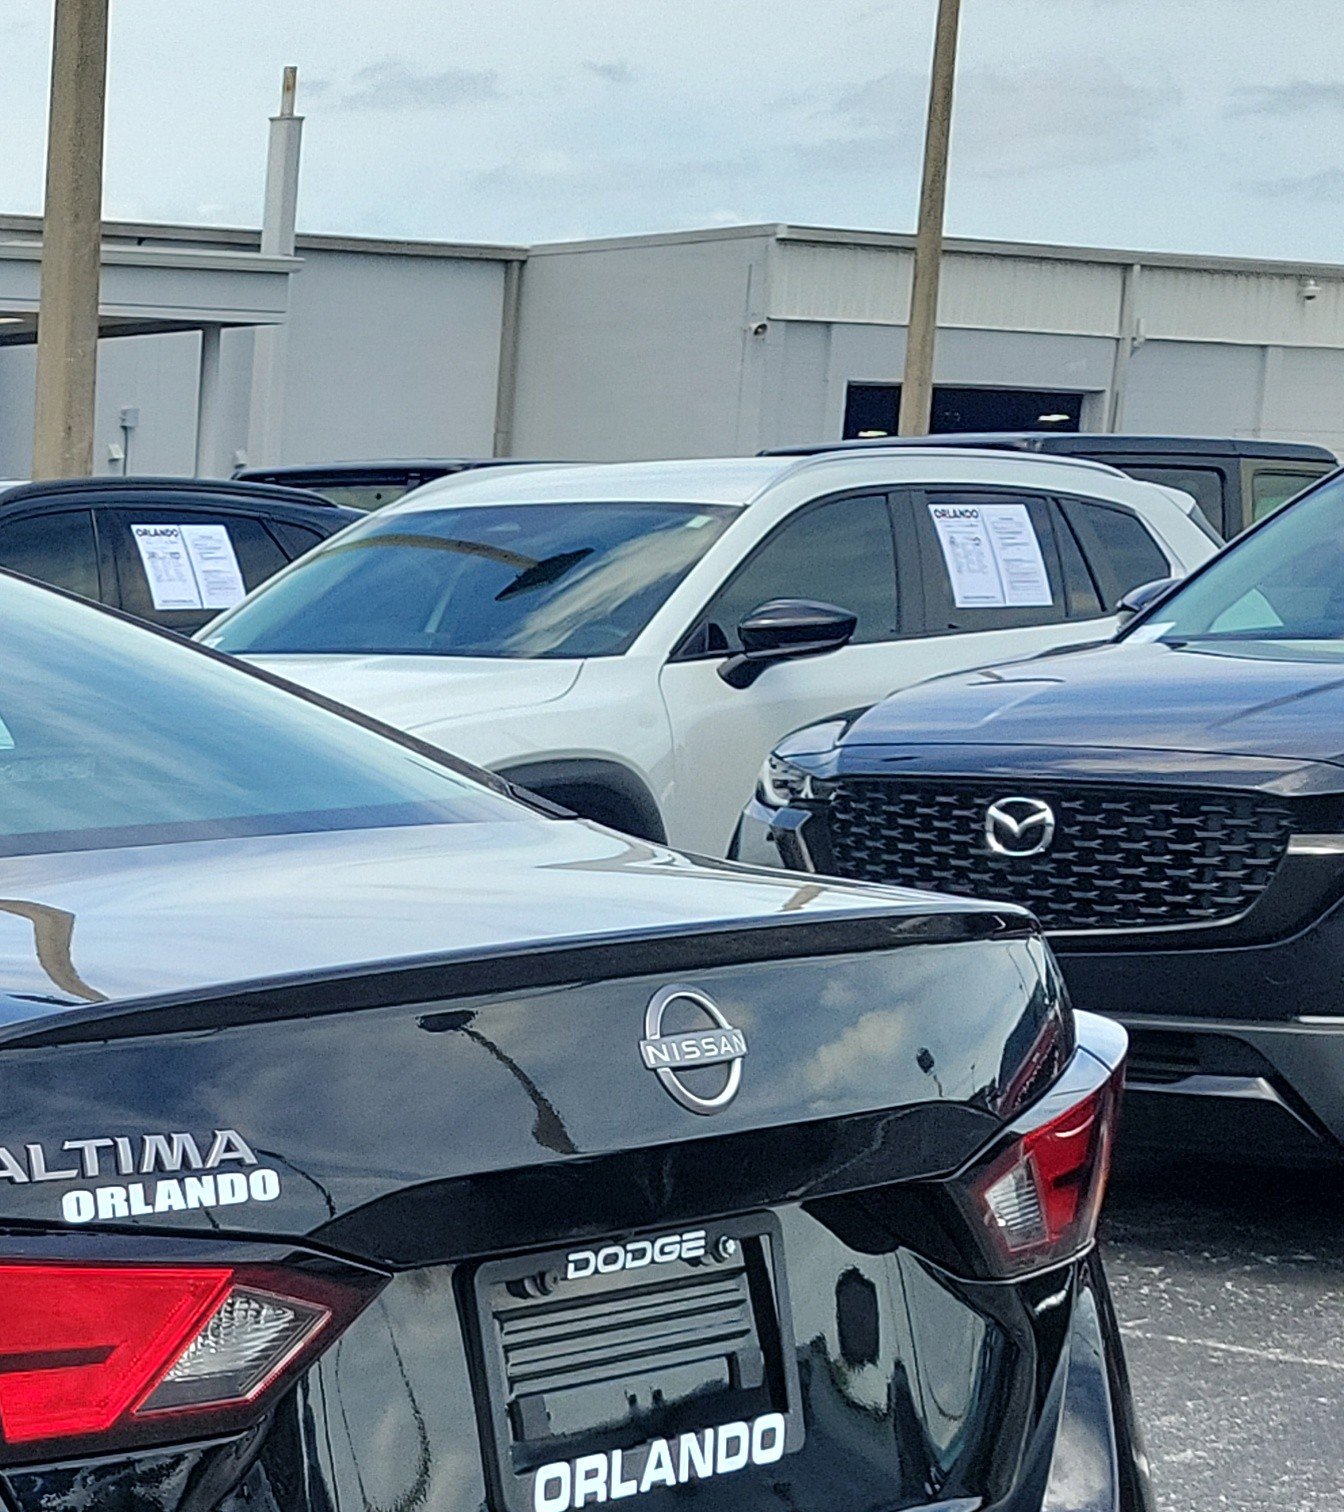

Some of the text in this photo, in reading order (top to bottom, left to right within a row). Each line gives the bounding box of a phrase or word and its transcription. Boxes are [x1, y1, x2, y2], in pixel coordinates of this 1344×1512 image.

[933, 508, 979, 519] ORLANDO
[135, 528, 179, 538] ORLANDO
[645, 1034, 747, 1065] NISSAN
[61, 1168, 281, 1223] ORLANDO
[566, 1230, 707, 1280] DODGE
